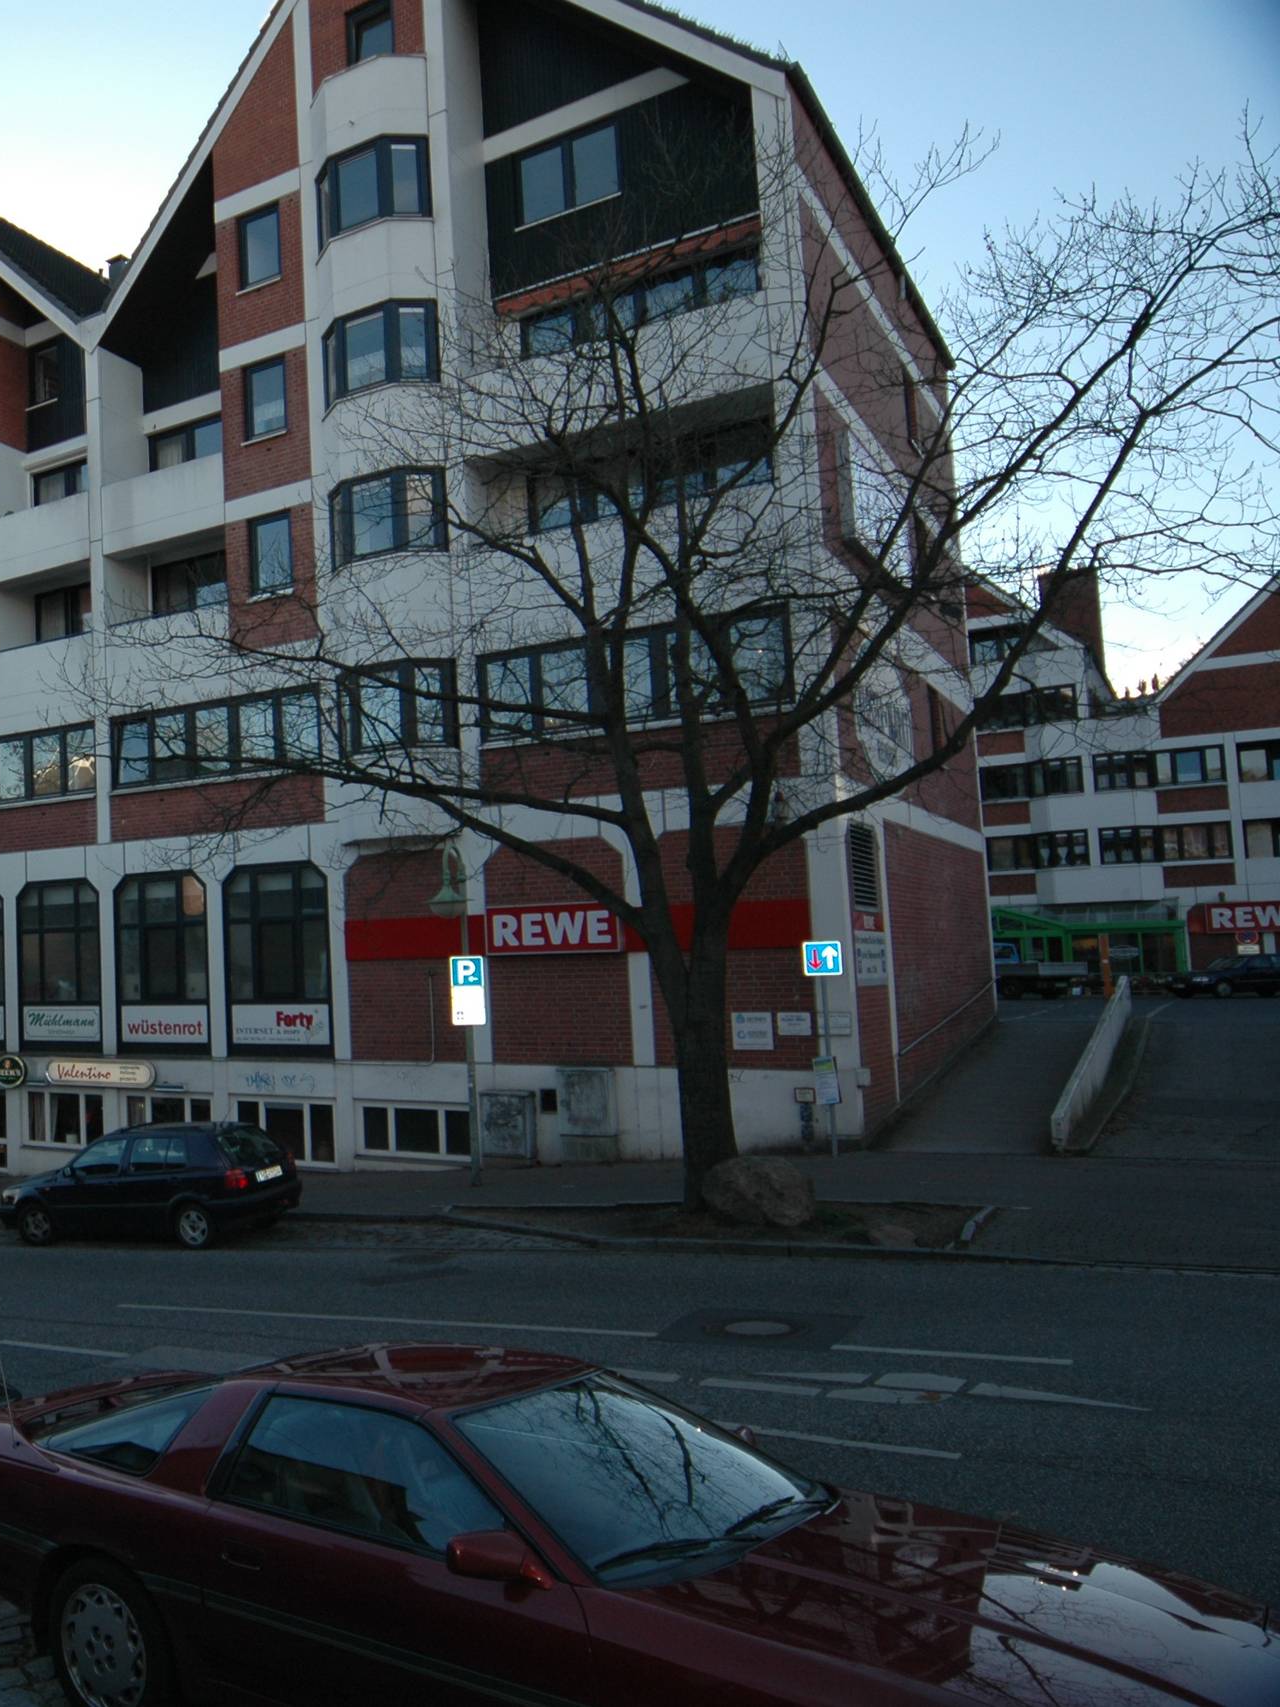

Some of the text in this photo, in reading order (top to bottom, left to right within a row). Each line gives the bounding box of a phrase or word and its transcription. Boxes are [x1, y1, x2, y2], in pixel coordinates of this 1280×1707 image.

[1211, 905, 1280, 928] REW
[492, 909, 612, 947] REWE
[456, 959, 476, 985] P
[28, 1012, 96, 1027] Mühlmann
[127, 1019, 203, 1036] wüstenrot
[276, 1010, 314, 1030] Forty
[57, 1063, 112, 1079] Valentino
